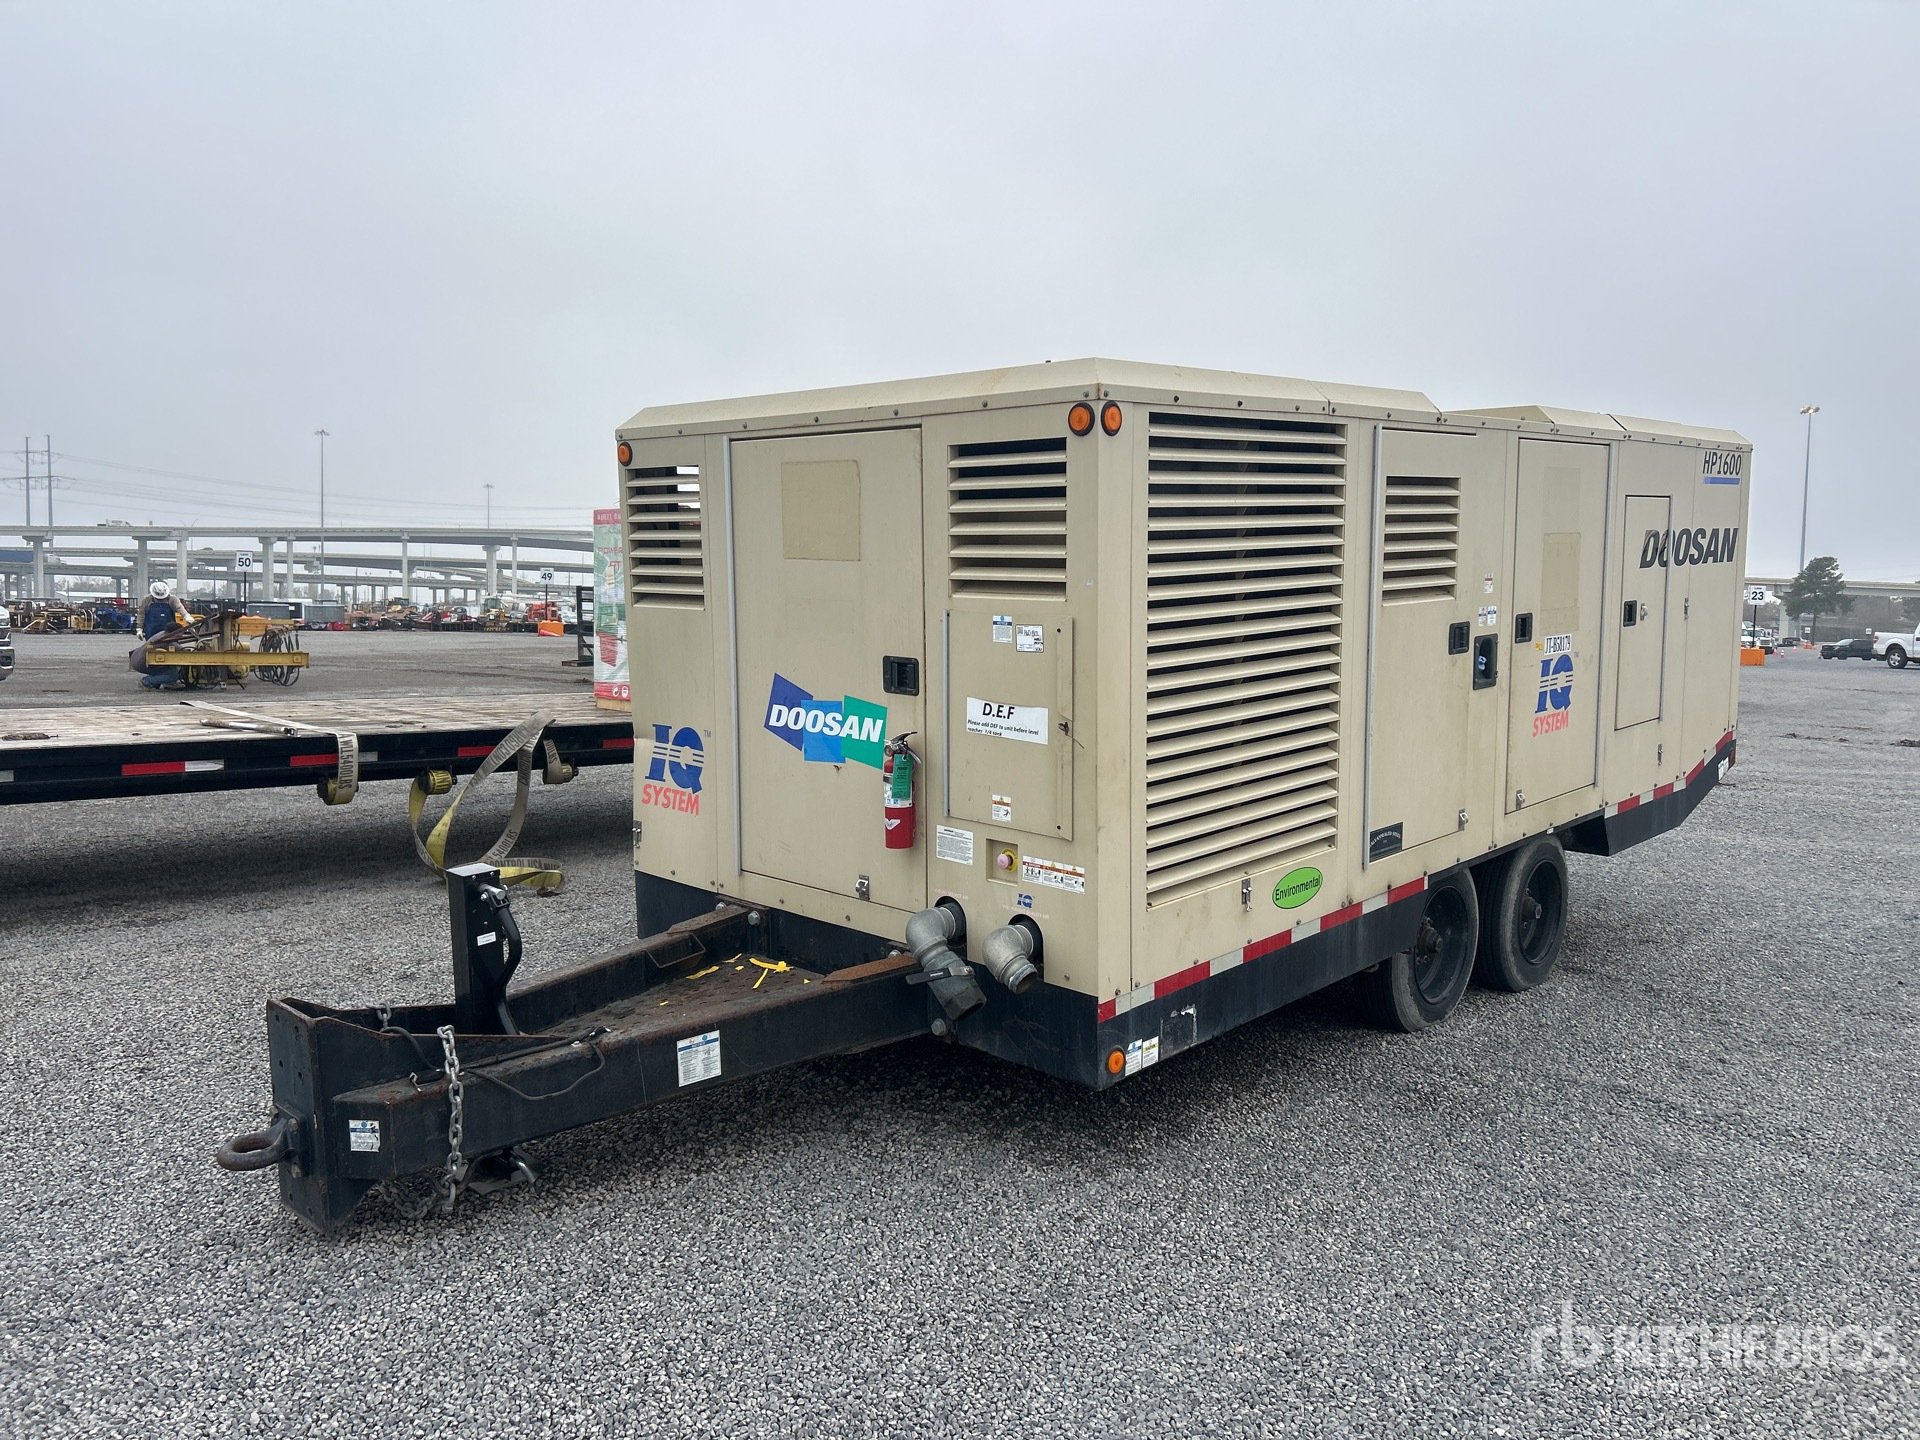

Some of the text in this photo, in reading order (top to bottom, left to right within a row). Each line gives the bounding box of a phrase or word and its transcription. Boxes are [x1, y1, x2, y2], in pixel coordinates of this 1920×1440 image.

[1702, 451, 1742, 476] HP1600
[1639, 527, 1739, 569] DOOSAN
[238, 557, 251, 567] 50
[541, 572, 553, 581] 49
[1751, 591, 1764, 601] 23
[1535, 653, 1574, 714] IQ
[982, 702, 1015, 719] D.E.F
[768, 704, 884, 743] DOOSAN
[1532, 710, 1569, 738] SYSTEM
[645, 723, 712, 794] IQ TM
[641, 783, 699, 816] SYSTEM
[1017, 892, 1033, 909] IQ
[1275, 876, 1321, 901] Environmental
